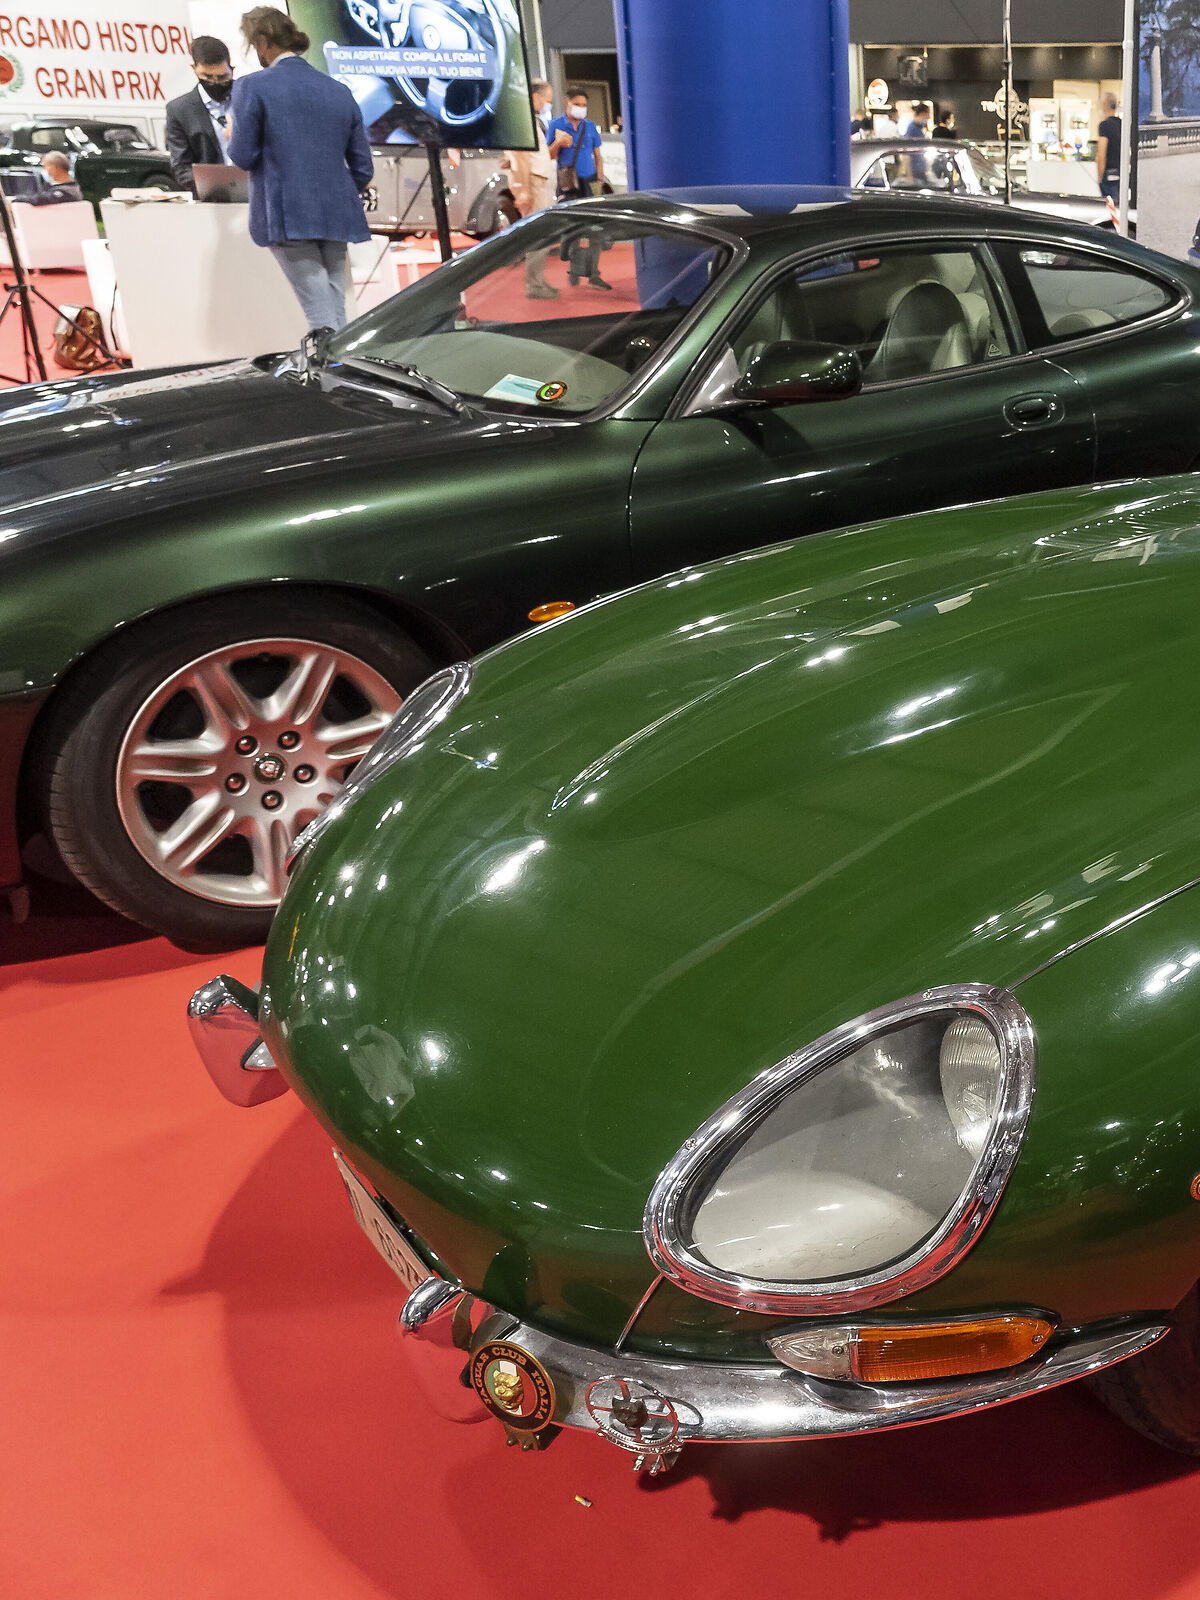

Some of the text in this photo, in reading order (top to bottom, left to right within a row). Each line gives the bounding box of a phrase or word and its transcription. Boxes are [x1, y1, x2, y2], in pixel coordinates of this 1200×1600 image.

[35, 67, 166, 101] GRAN PRIX
[475, 1347, 549, 1420] JAGUAR CLUB ITALIA
